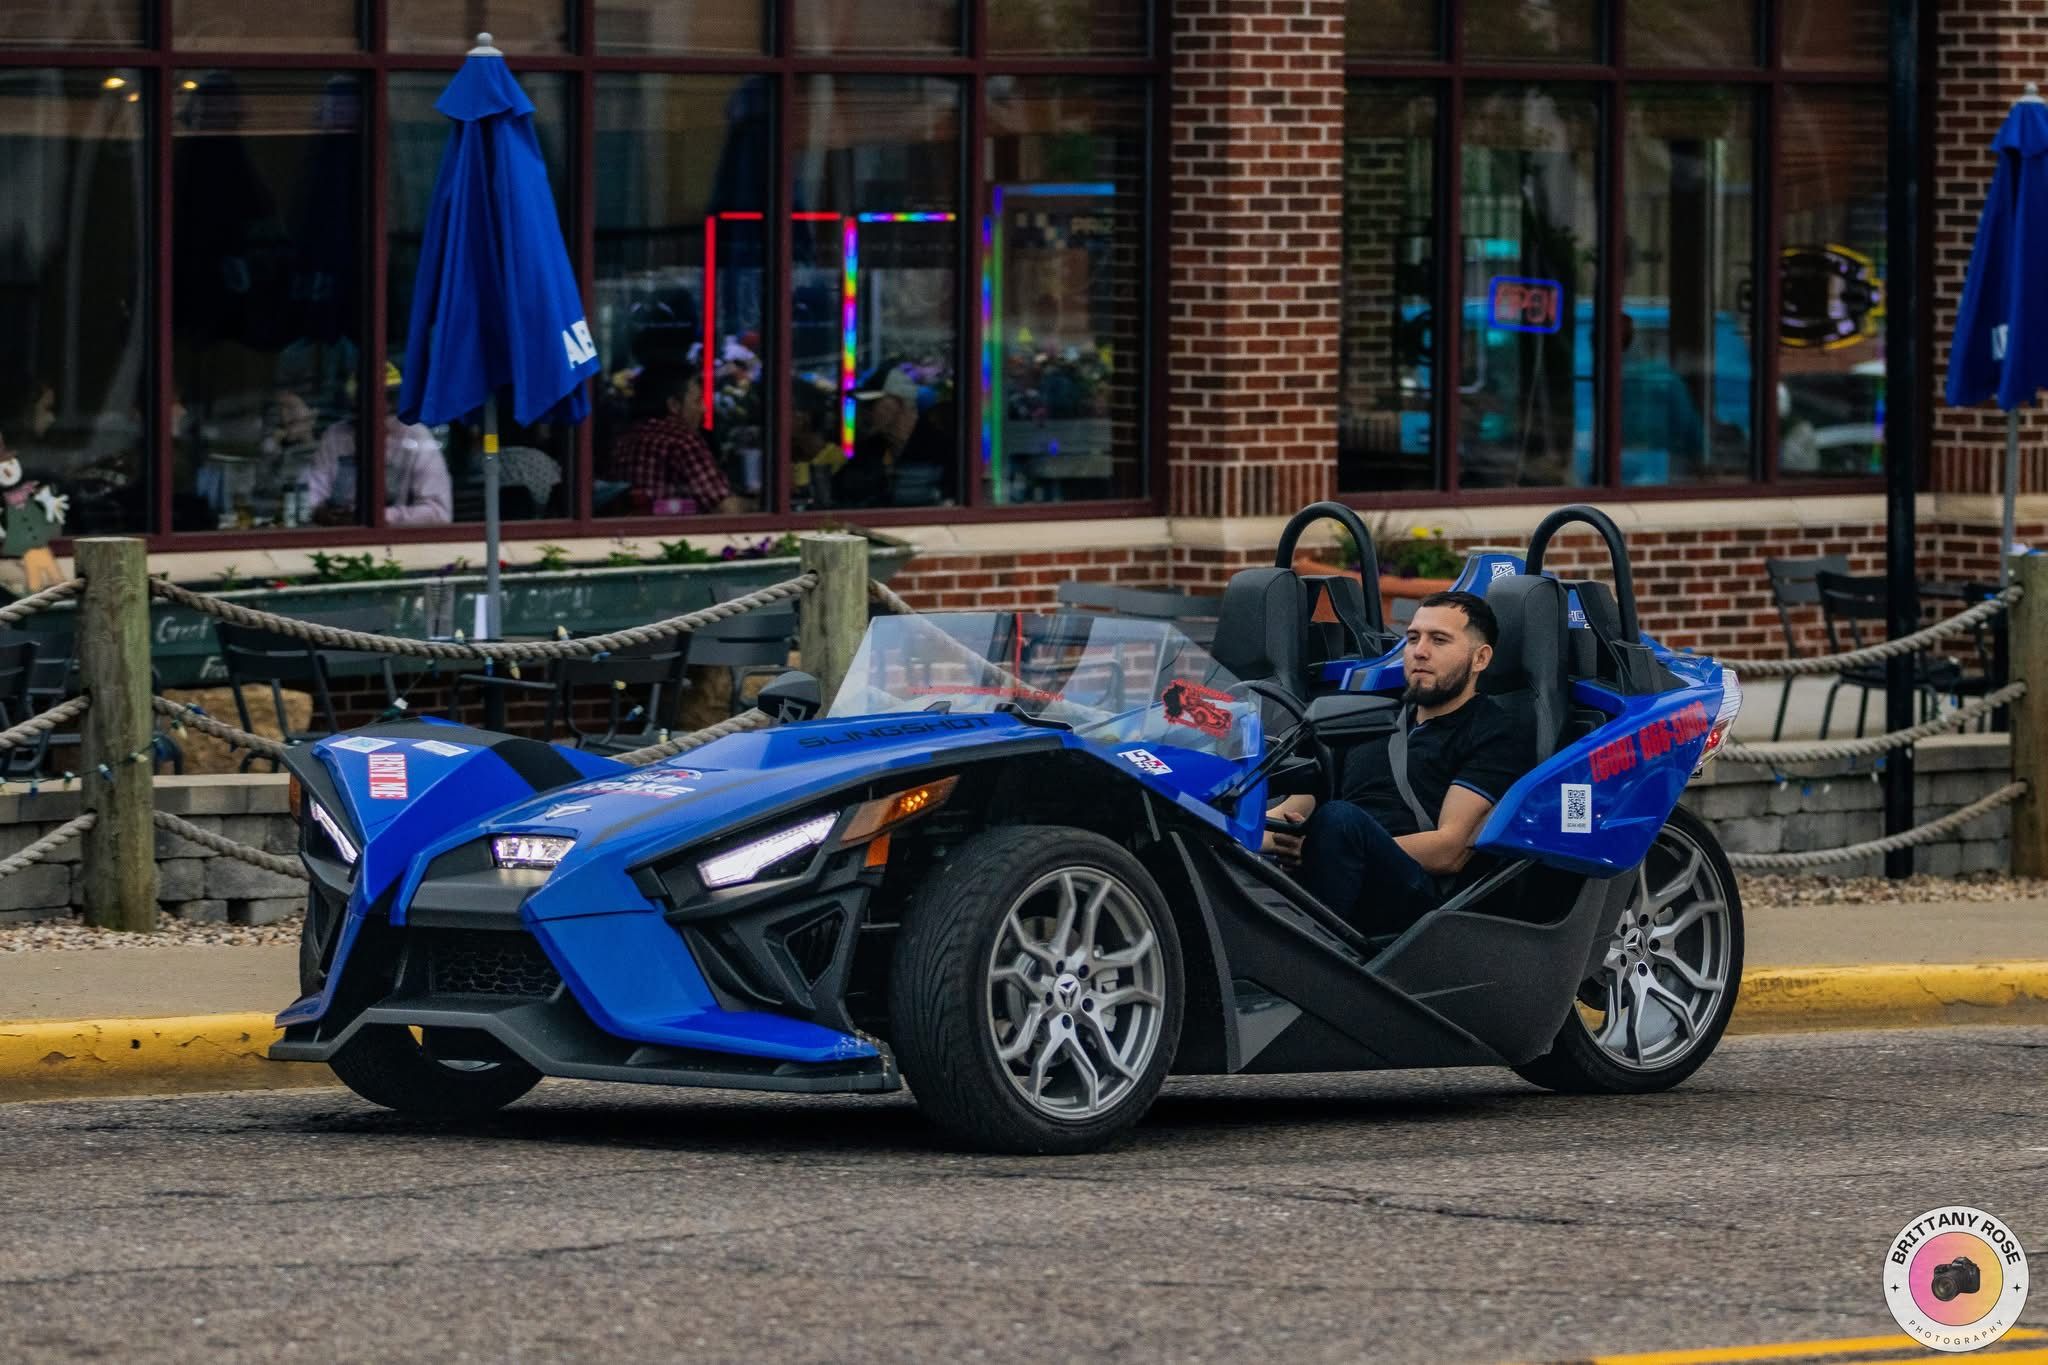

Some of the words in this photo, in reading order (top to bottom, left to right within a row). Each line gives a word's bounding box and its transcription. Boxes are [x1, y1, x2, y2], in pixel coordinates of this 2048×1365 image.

[797, 715, 992, 749] SLINGSHOT
[368, 754, 405, 779] RENT
[370, 782, 408, 799] ME
